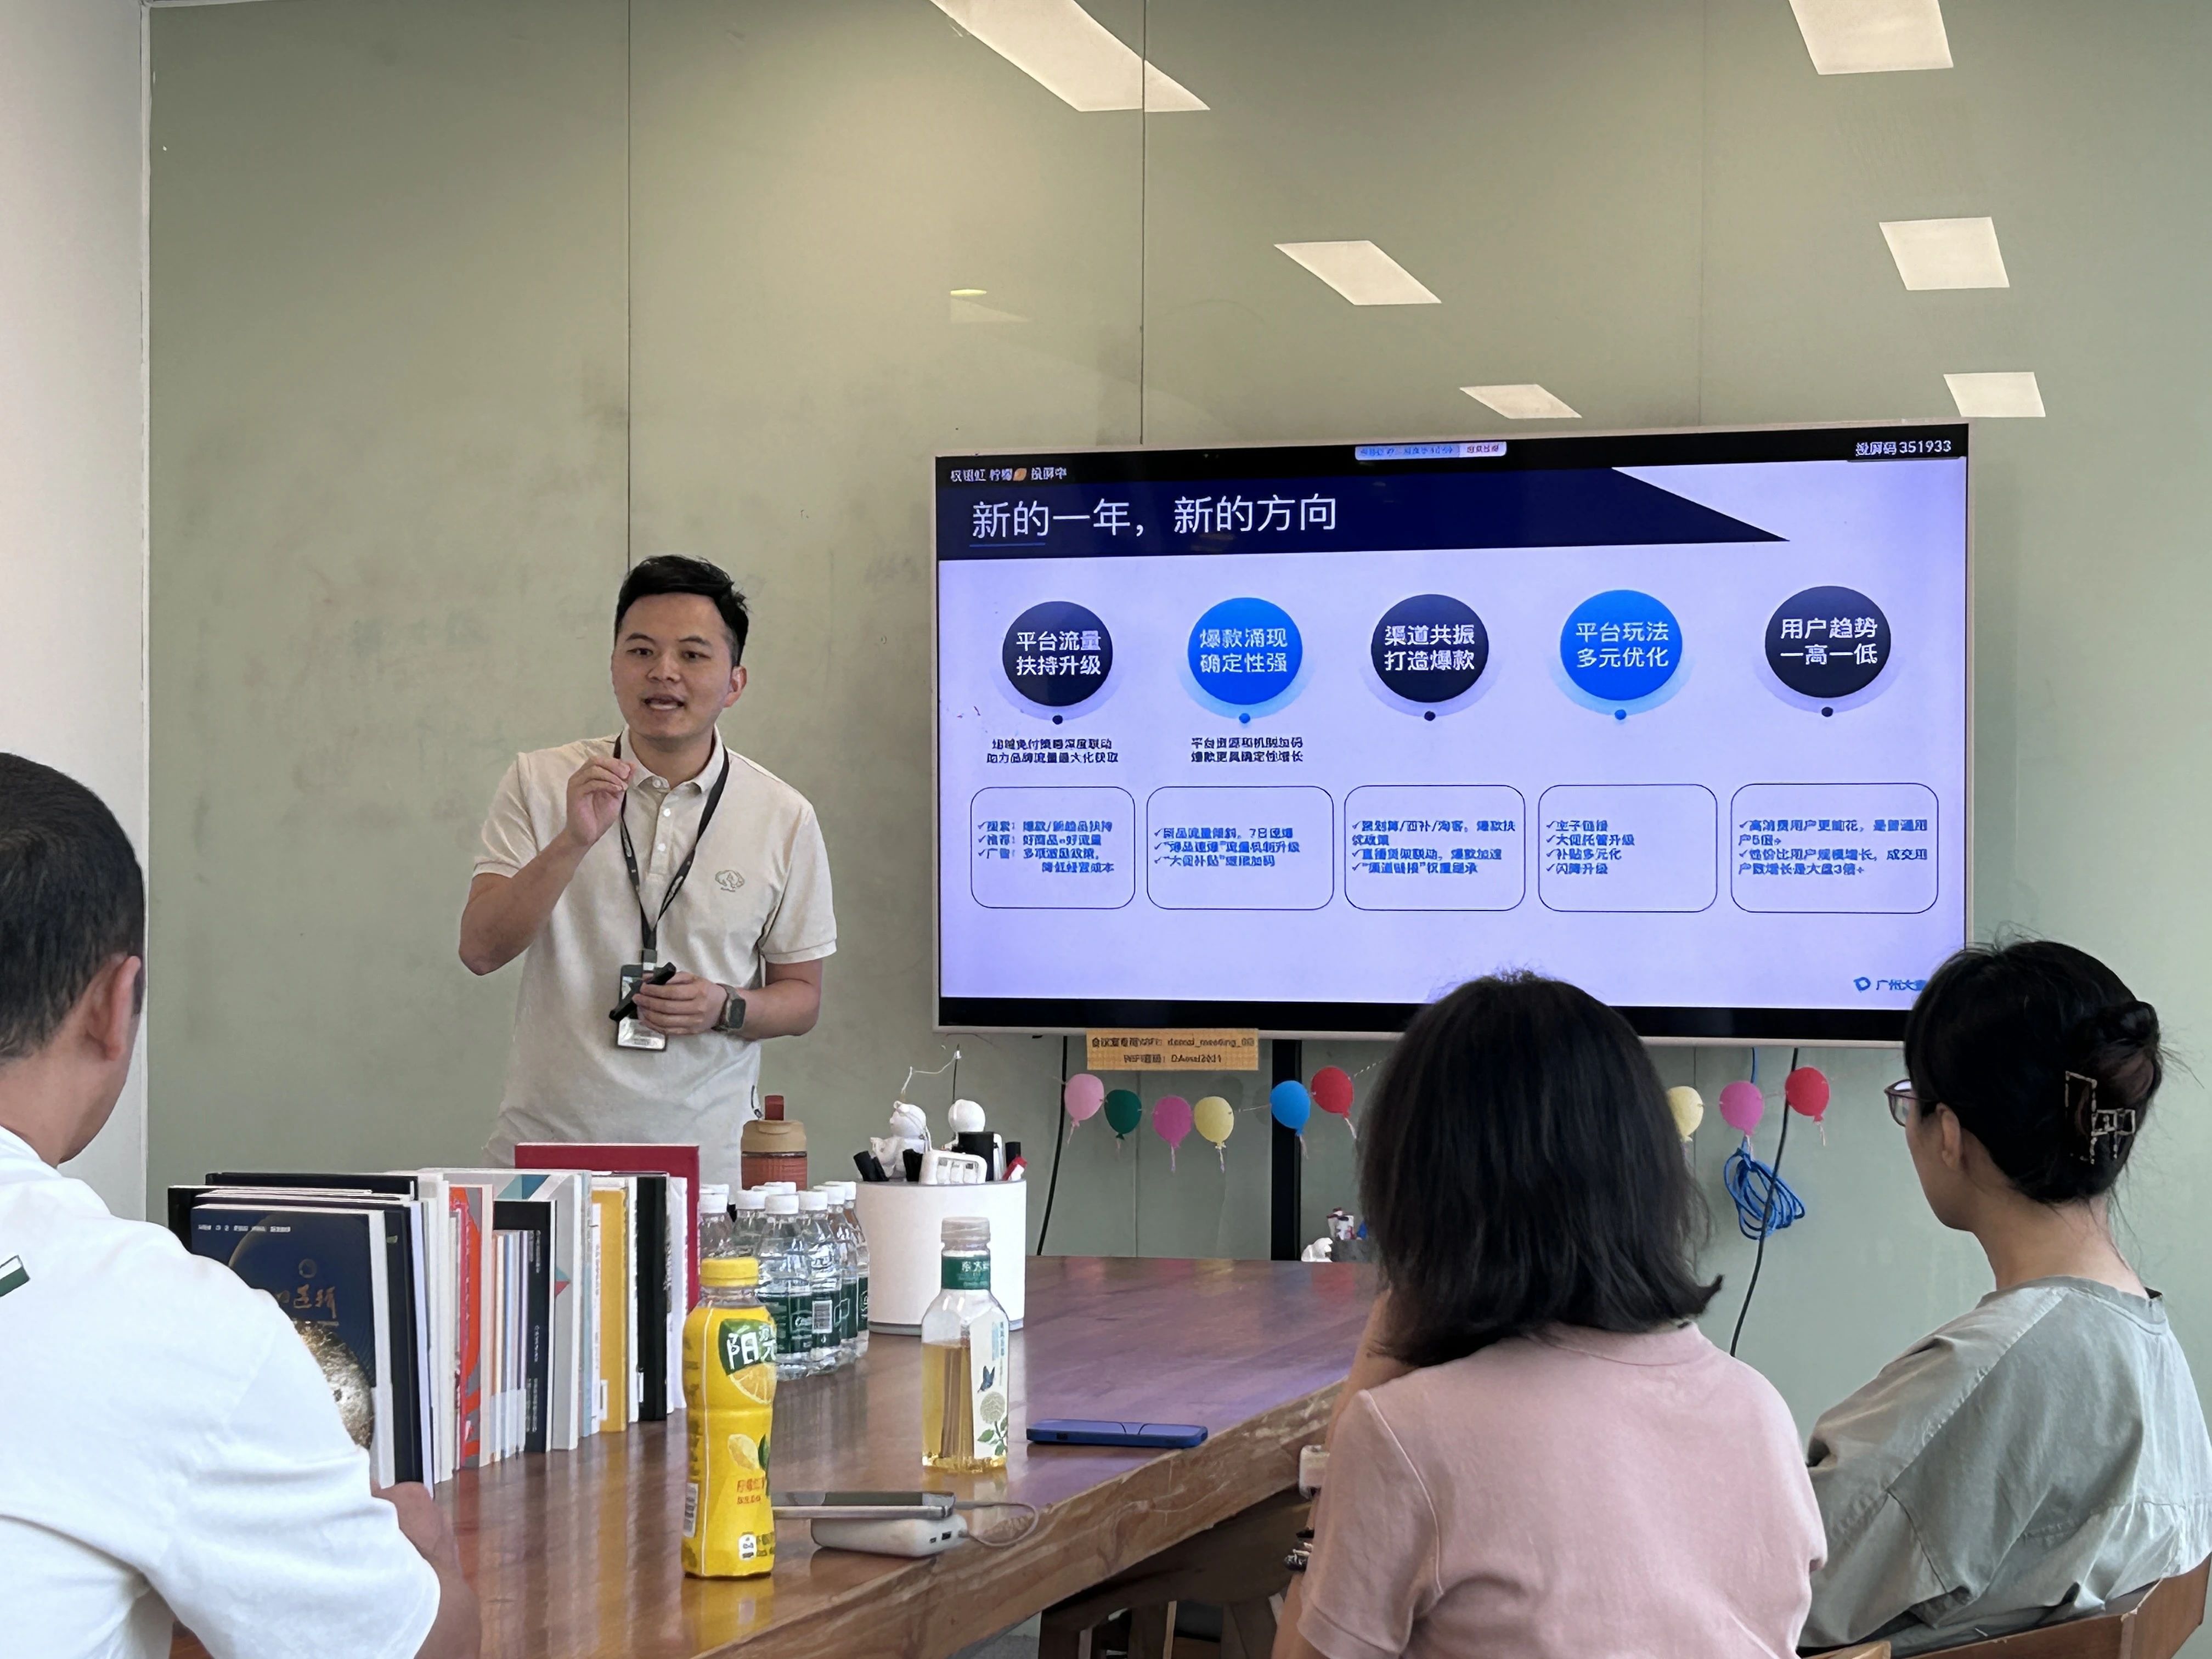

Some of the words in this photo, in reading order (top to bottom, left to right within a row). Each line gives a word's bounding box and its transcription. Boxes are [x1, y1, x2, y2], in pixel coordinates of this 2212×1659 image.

[1899, 440, 1951, 453] 351933
[1200, 628, 1288, 648] 爆款涌现
[1384, 624, 1475, 646] 渠道共振
[1576, 622, 1669, 642] 平台玩法
[1781, 617, 1878, 639] 用户趋势
[1015, 630, 1102, 651] 平台流量
[1200, 652, 1288, 674] 确定性强
[1384, 650, 1475, 672] 打造爆款
[1576, 647, 1669, 668] 多元优化
[1781, 643, 1878, 665] 一高一低
[1015, 655, 1102, 676] 扶持升级
